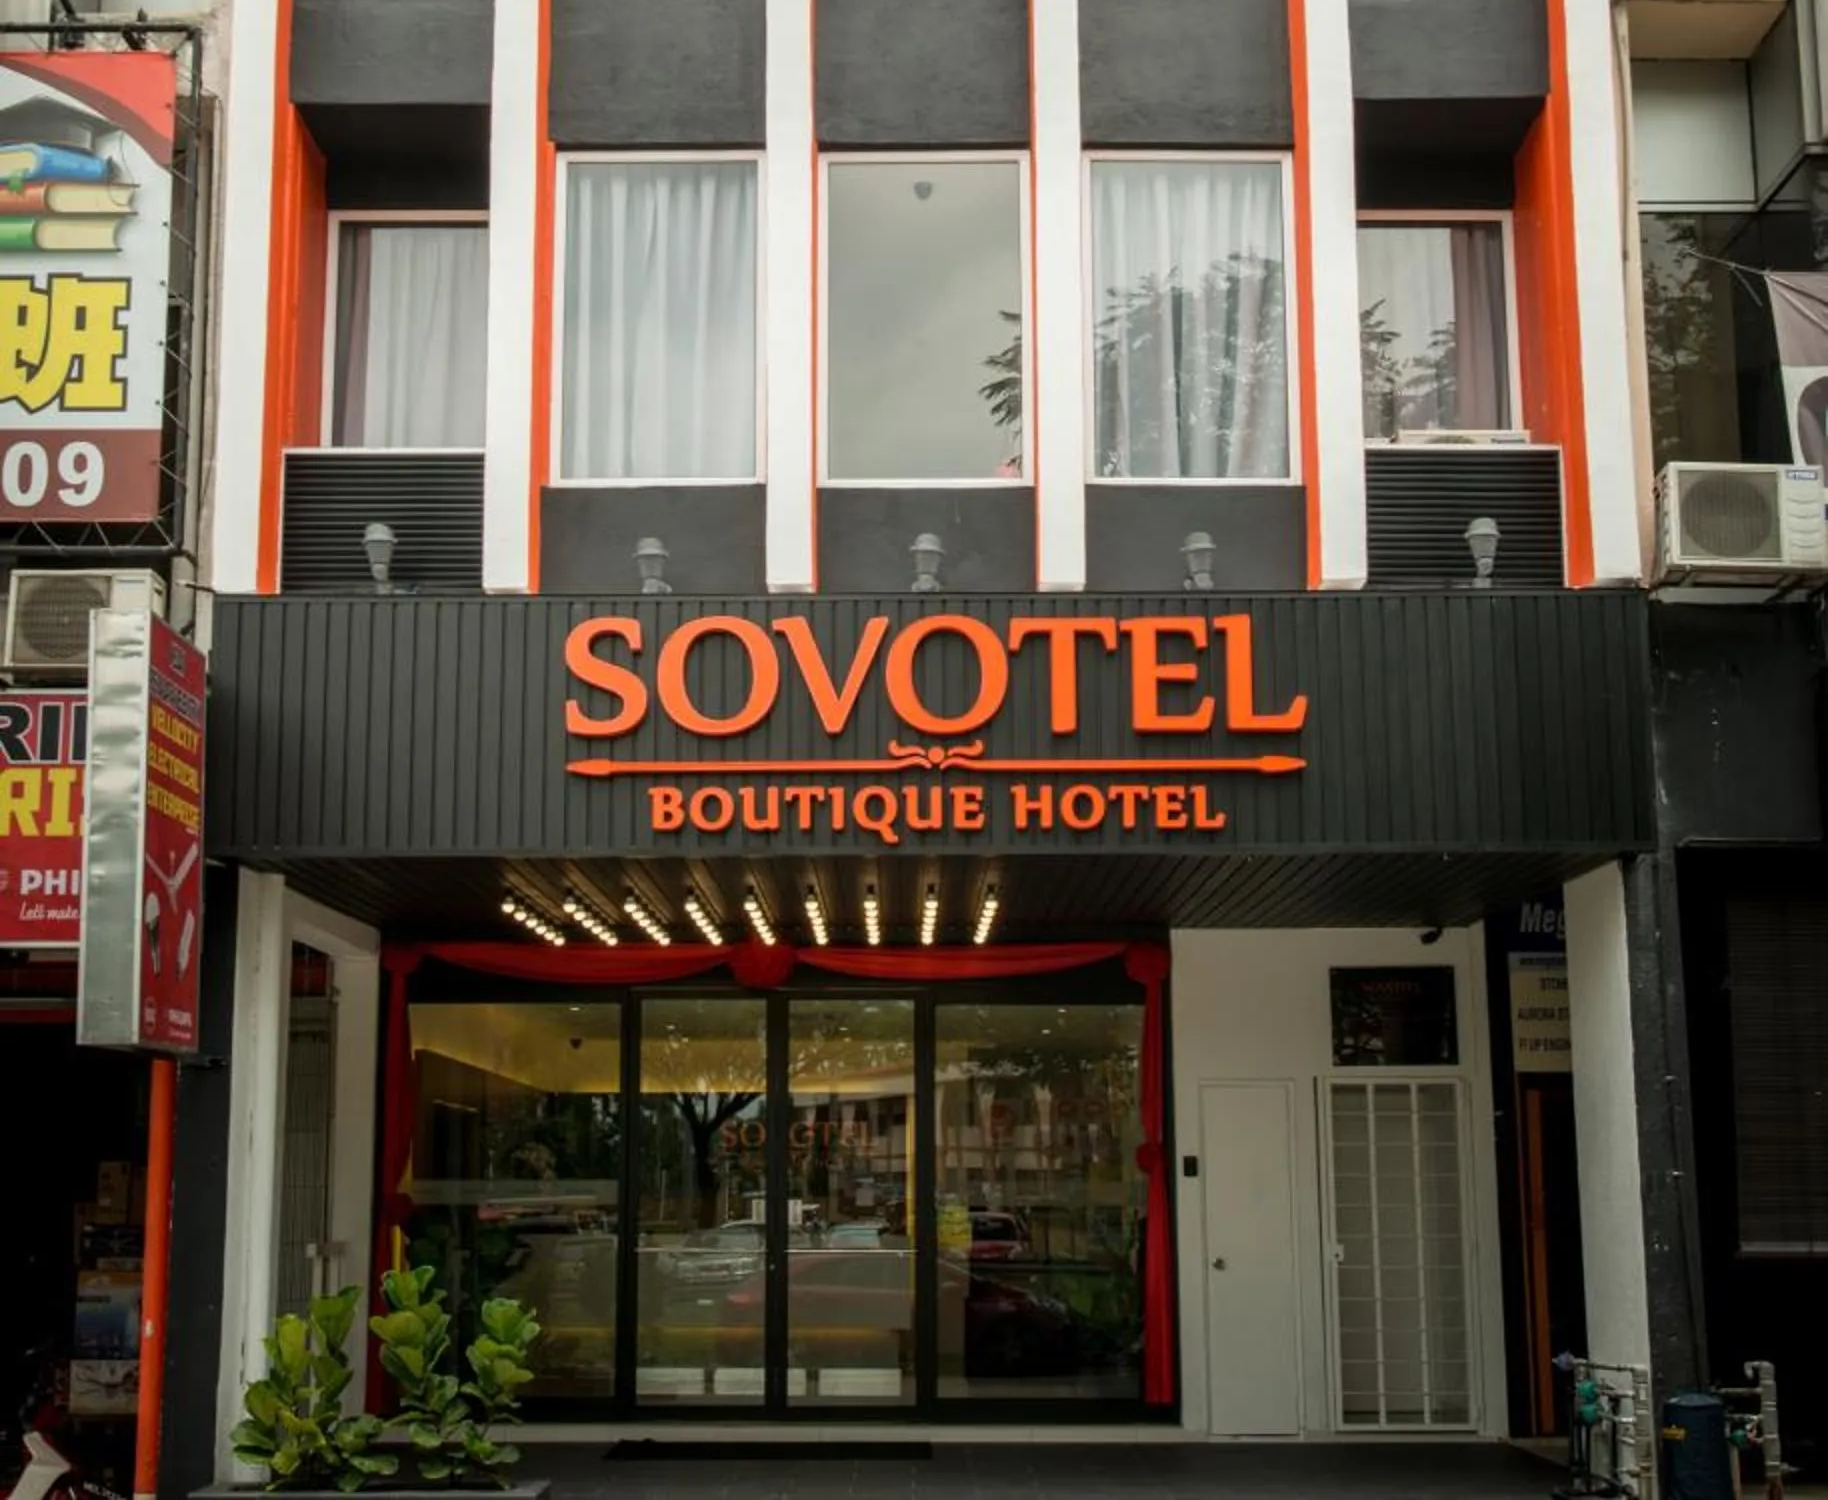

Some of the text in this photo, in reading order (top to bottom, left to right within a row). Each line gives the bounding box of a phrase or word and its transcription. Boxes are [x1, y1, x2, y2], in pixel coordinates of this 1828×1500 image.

[2, 441, 104, 507] 09
[564, 613, 1308, 738] SOVOTEL
[648, 785, 1227, 844] BOUTIQUE HOTEL
[19, 868, 80, 896] PHI
